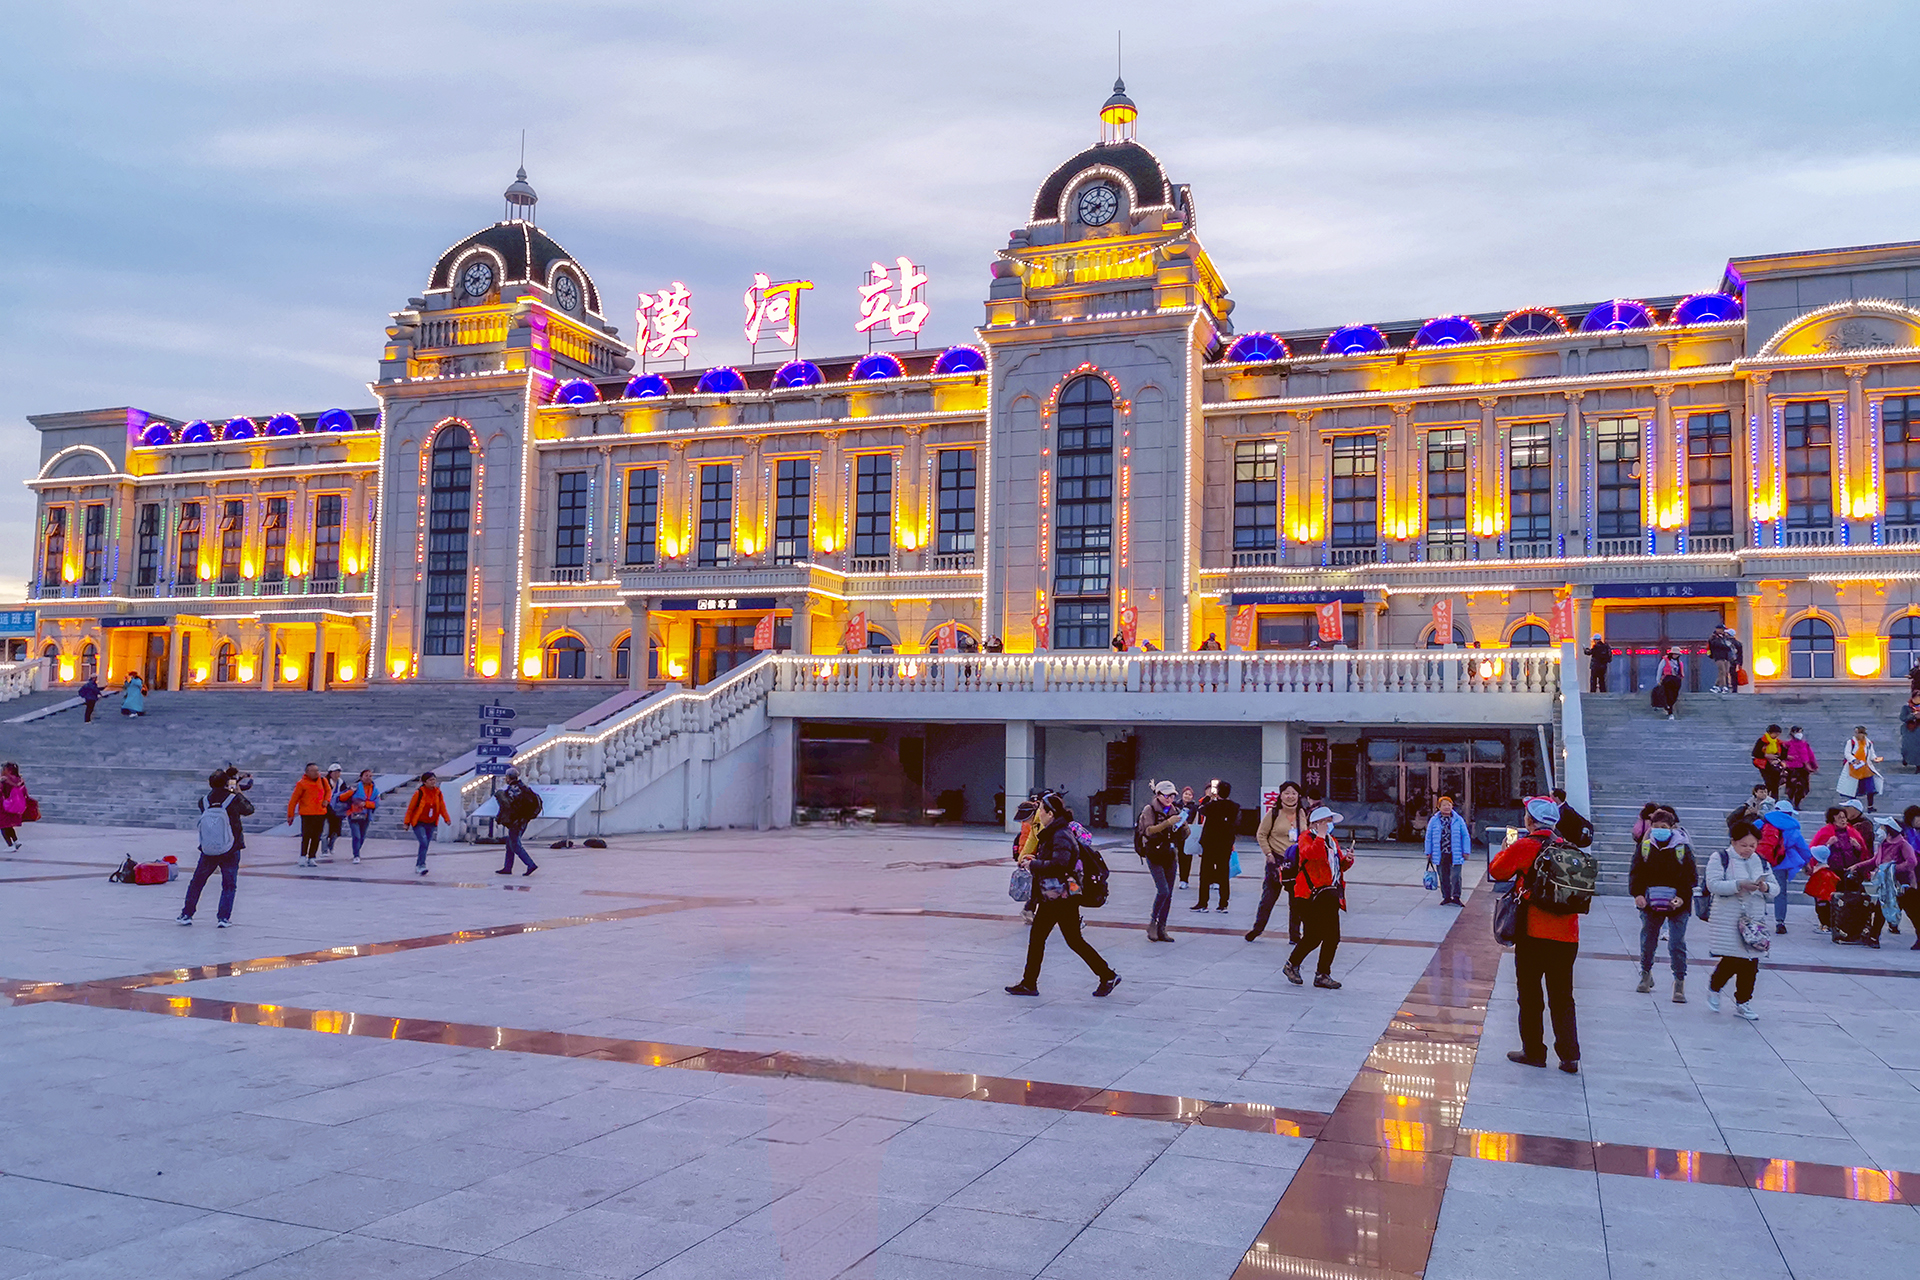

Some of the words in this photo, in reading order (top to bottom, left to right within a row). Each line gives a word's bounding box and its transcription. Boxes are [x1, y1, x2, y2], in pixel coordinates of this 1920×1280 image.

[635, 256, 930, 358] 漠河站
[1650, 586, 1693, 596] 售票处
